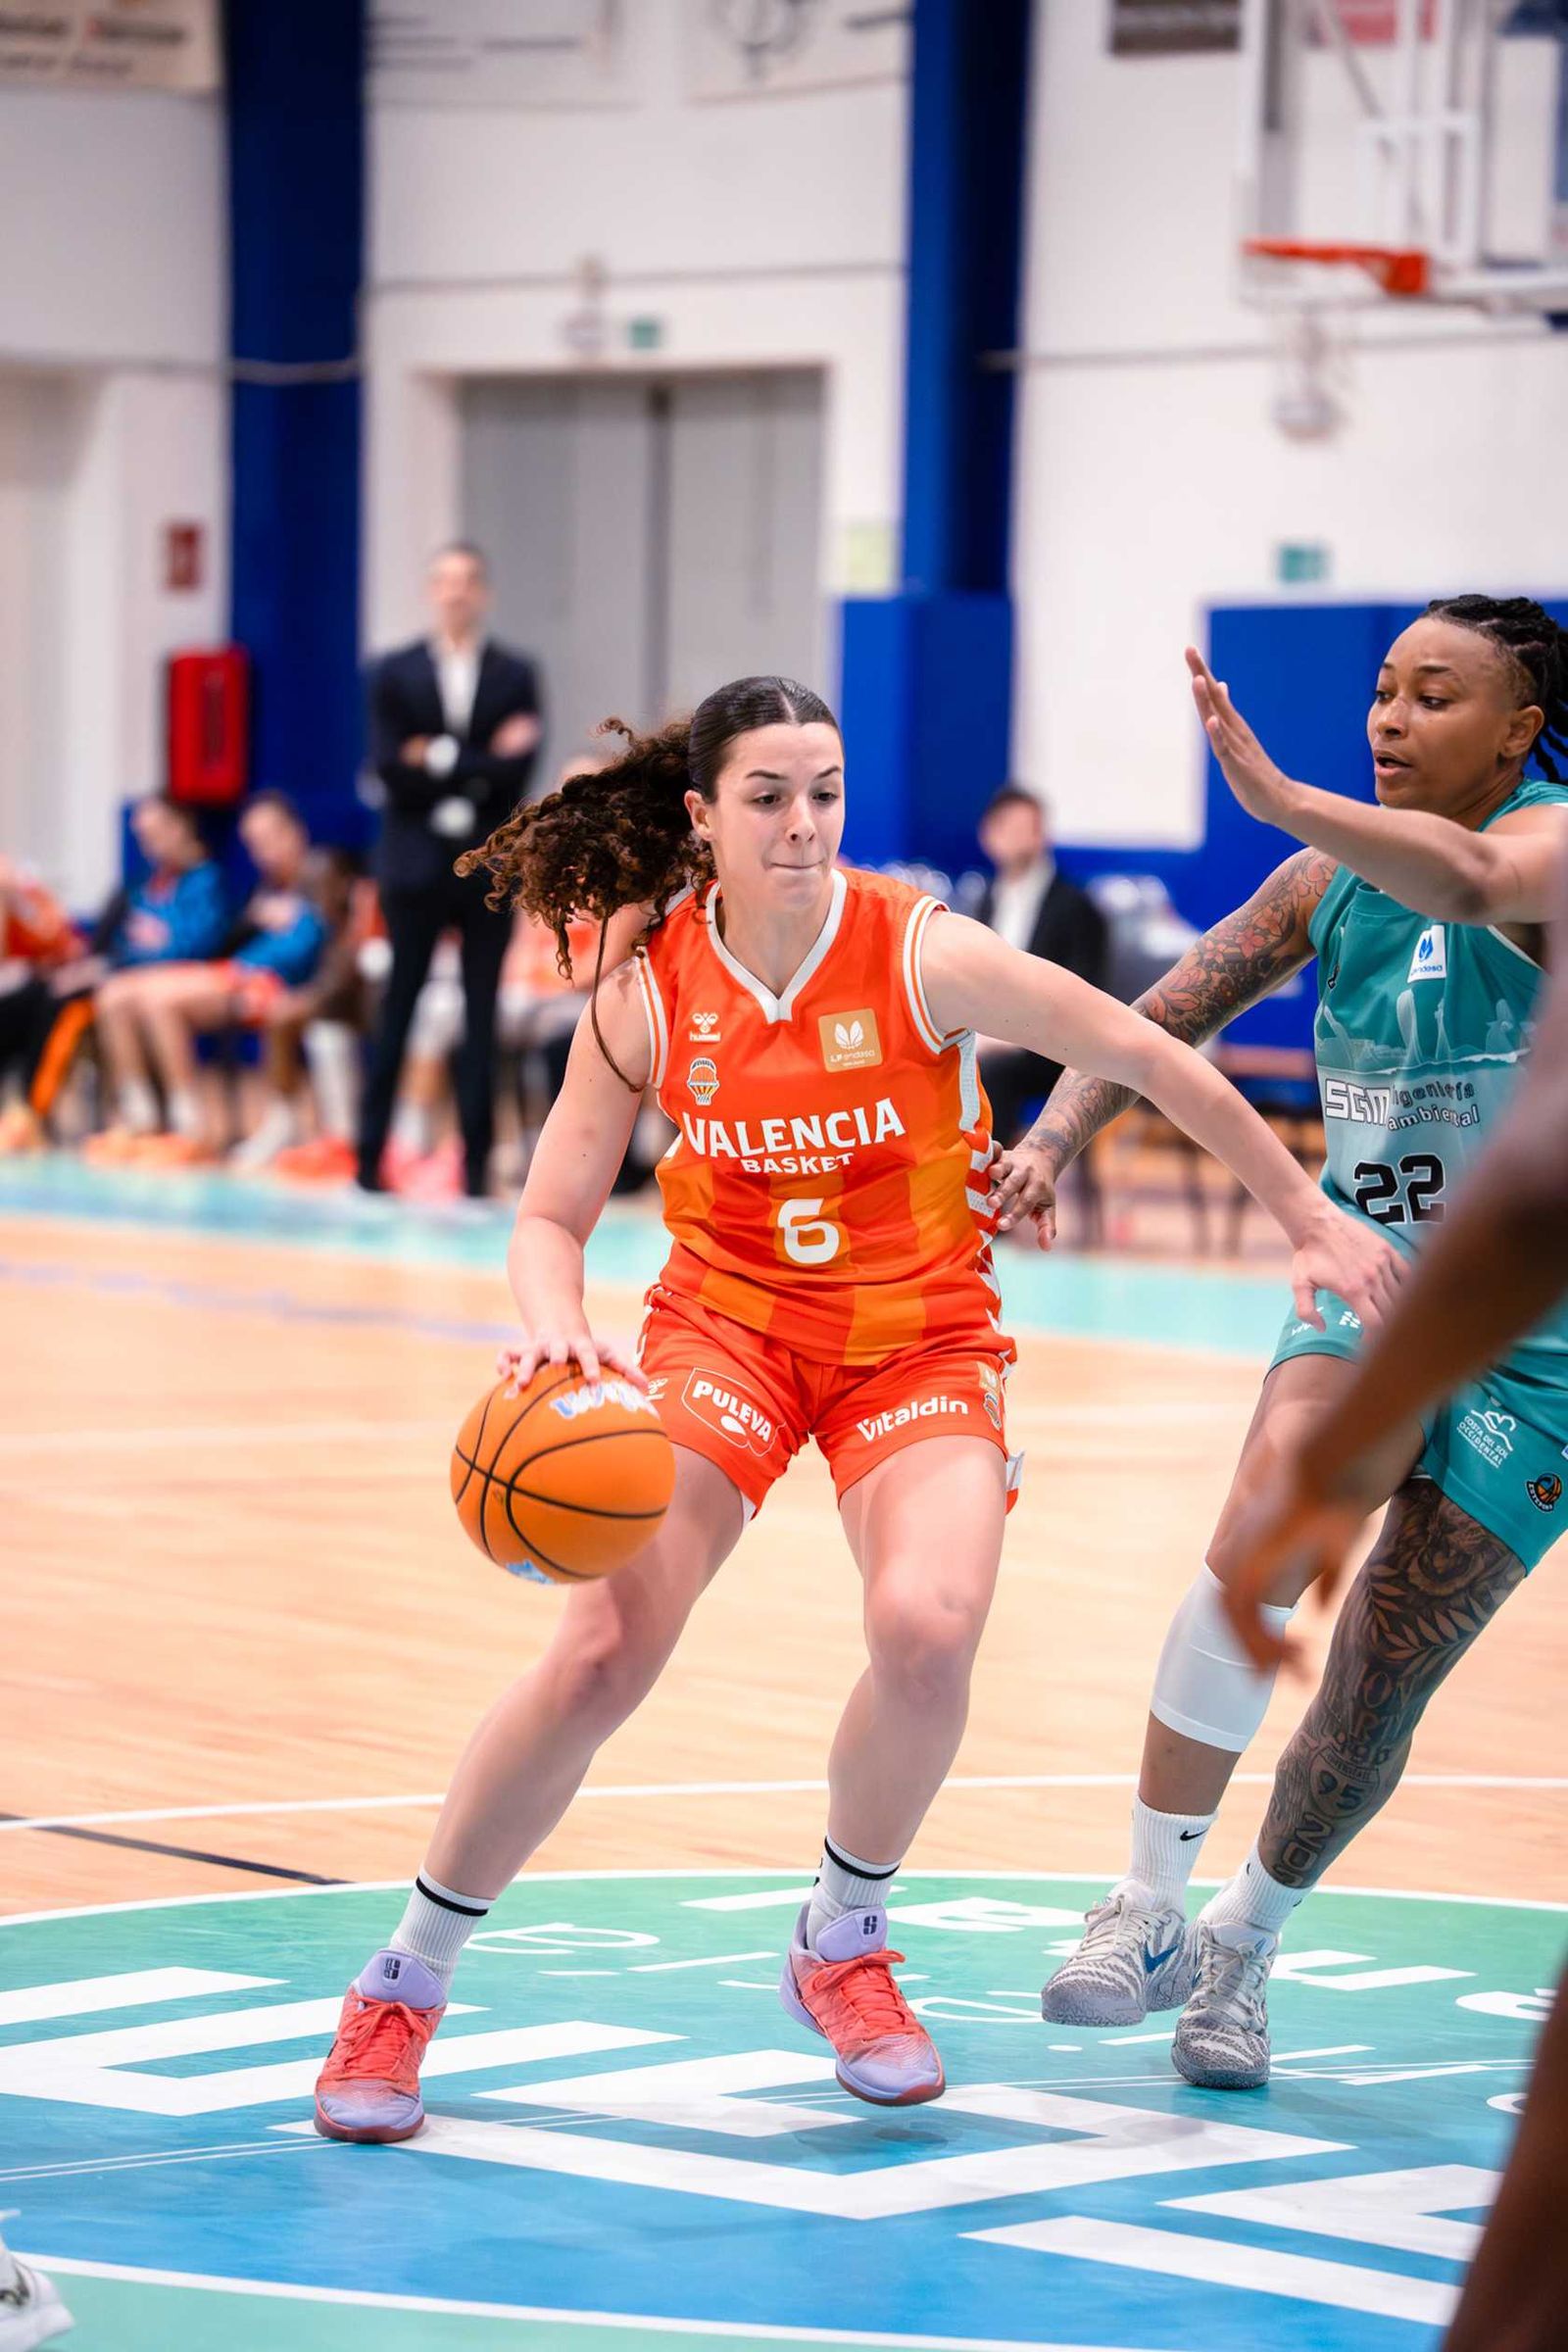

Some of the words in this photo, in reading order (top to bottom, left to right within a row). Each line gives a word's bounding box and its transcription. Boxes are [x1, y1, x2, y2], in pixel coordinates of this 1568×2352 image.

[1325, 1078, 1390, 1126] SGM
[683, 1098, 906, 1158] VALENCIA
[741, 1152, 854, 1175] BASKET
[1353, 1153, 1446, 1225] 22
[777, 1198, 840, 1264] 6
[691, 1380, 775, 1443] PULEVA
[856, 1396, 969, 1443] Vitaldin
[1458, 1421, 1503, 1465] OCCIDENTAL
[1463, 1415, 1485, 1438] COSTA
[1483, 1434, 1495, 1447] DEL
[1494, 1445, 1508, 1459] SOL
